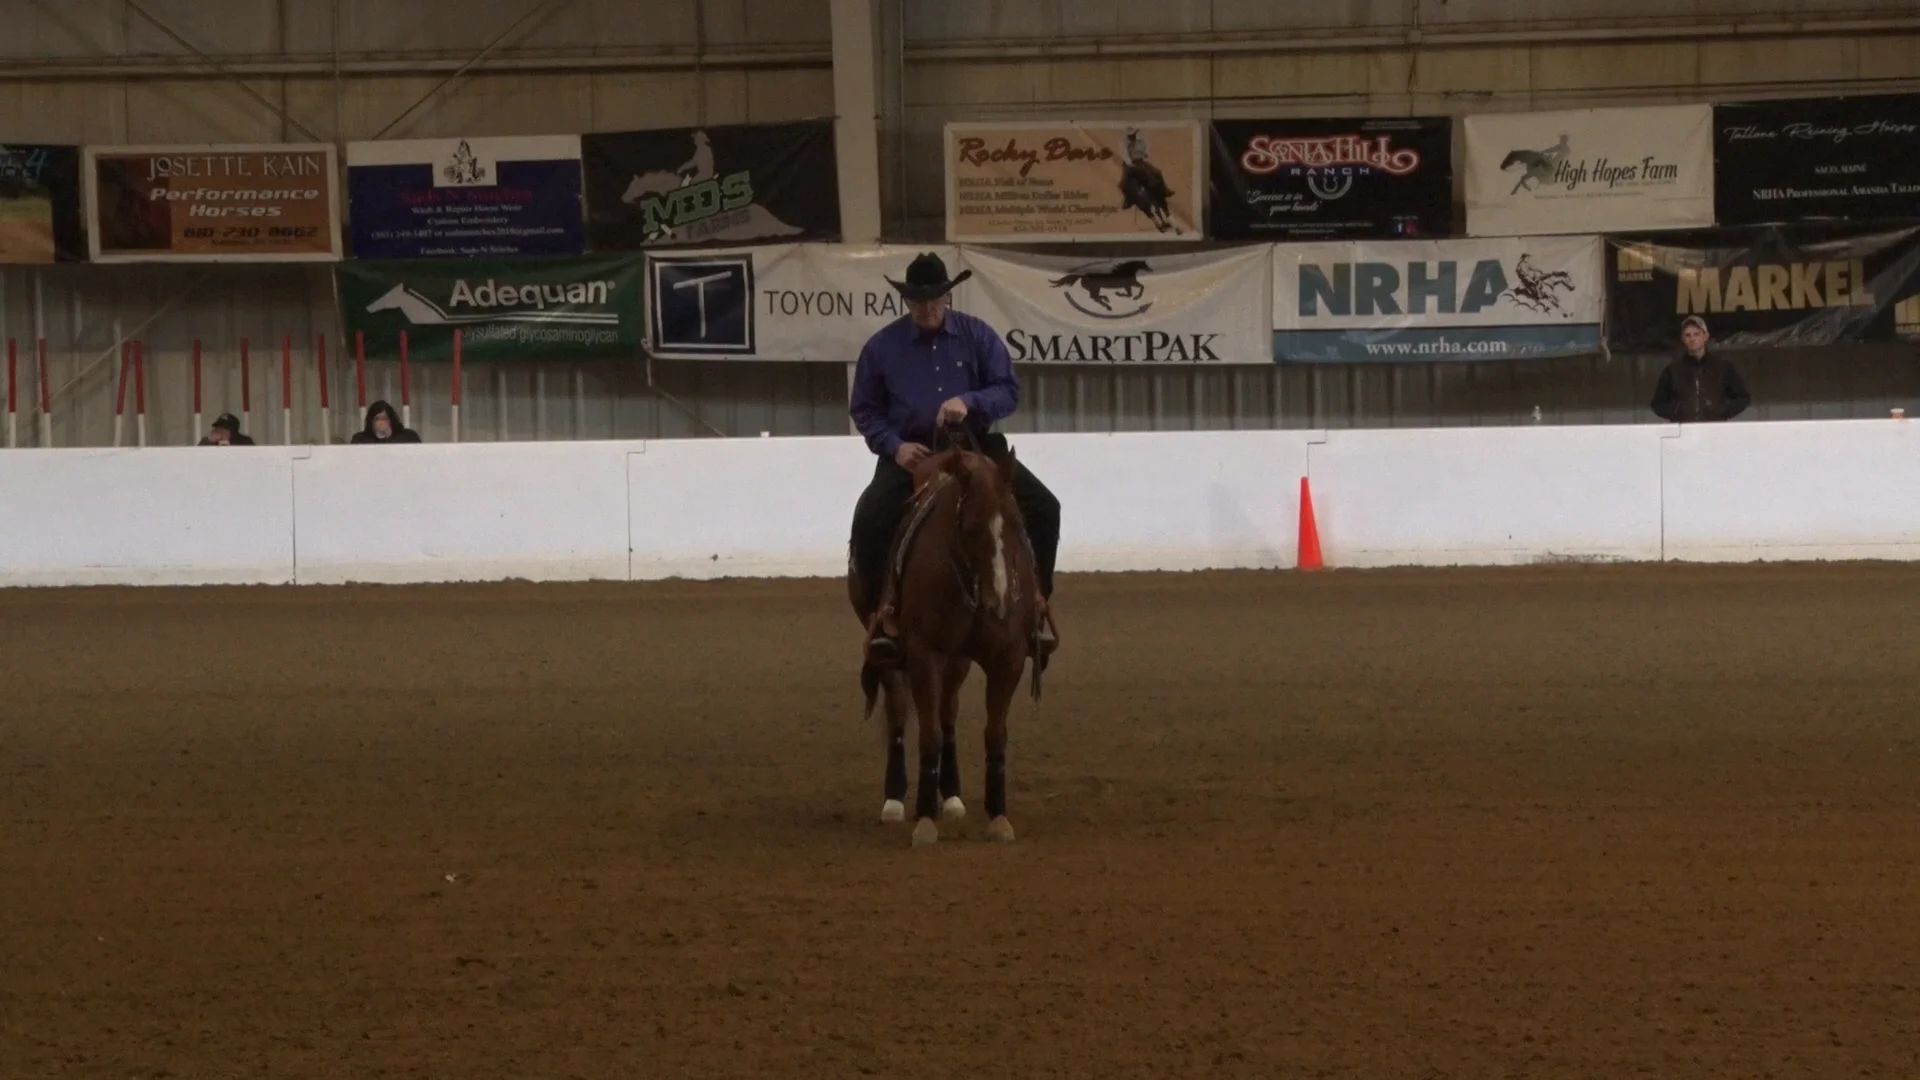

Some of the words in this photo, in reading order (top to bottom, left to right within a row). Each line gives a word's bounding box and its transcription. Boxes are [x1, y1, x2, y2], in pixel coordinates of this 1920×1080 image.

[1781, 121, 1853, 144] Reining
[147, 155, 251, 181] JOSETTE
[263, 155, 319, 177] KAIN
[958, 137, 1041, 177] Rocky
[1290, 167, 1371, 176] RANCH
[1553, 159, 1587, 191] High
[1592, 157, 1636, 189] Hopes
[1640, 155, 1679, 180] Farm
[150, 187, 319, 201] Performance
[1752, 187, 1785, 201] NRHA
[189, 203, 282, 217] Horses
[449, 278, 607, 311] Adequan
[1298, 259, 1509, 317] NRHA
[1675, 257, 1877, 315] MARKEL
[763, 290, 853, 317] TOYON
[1366, 337, 1507, 356] www.nrha.com
